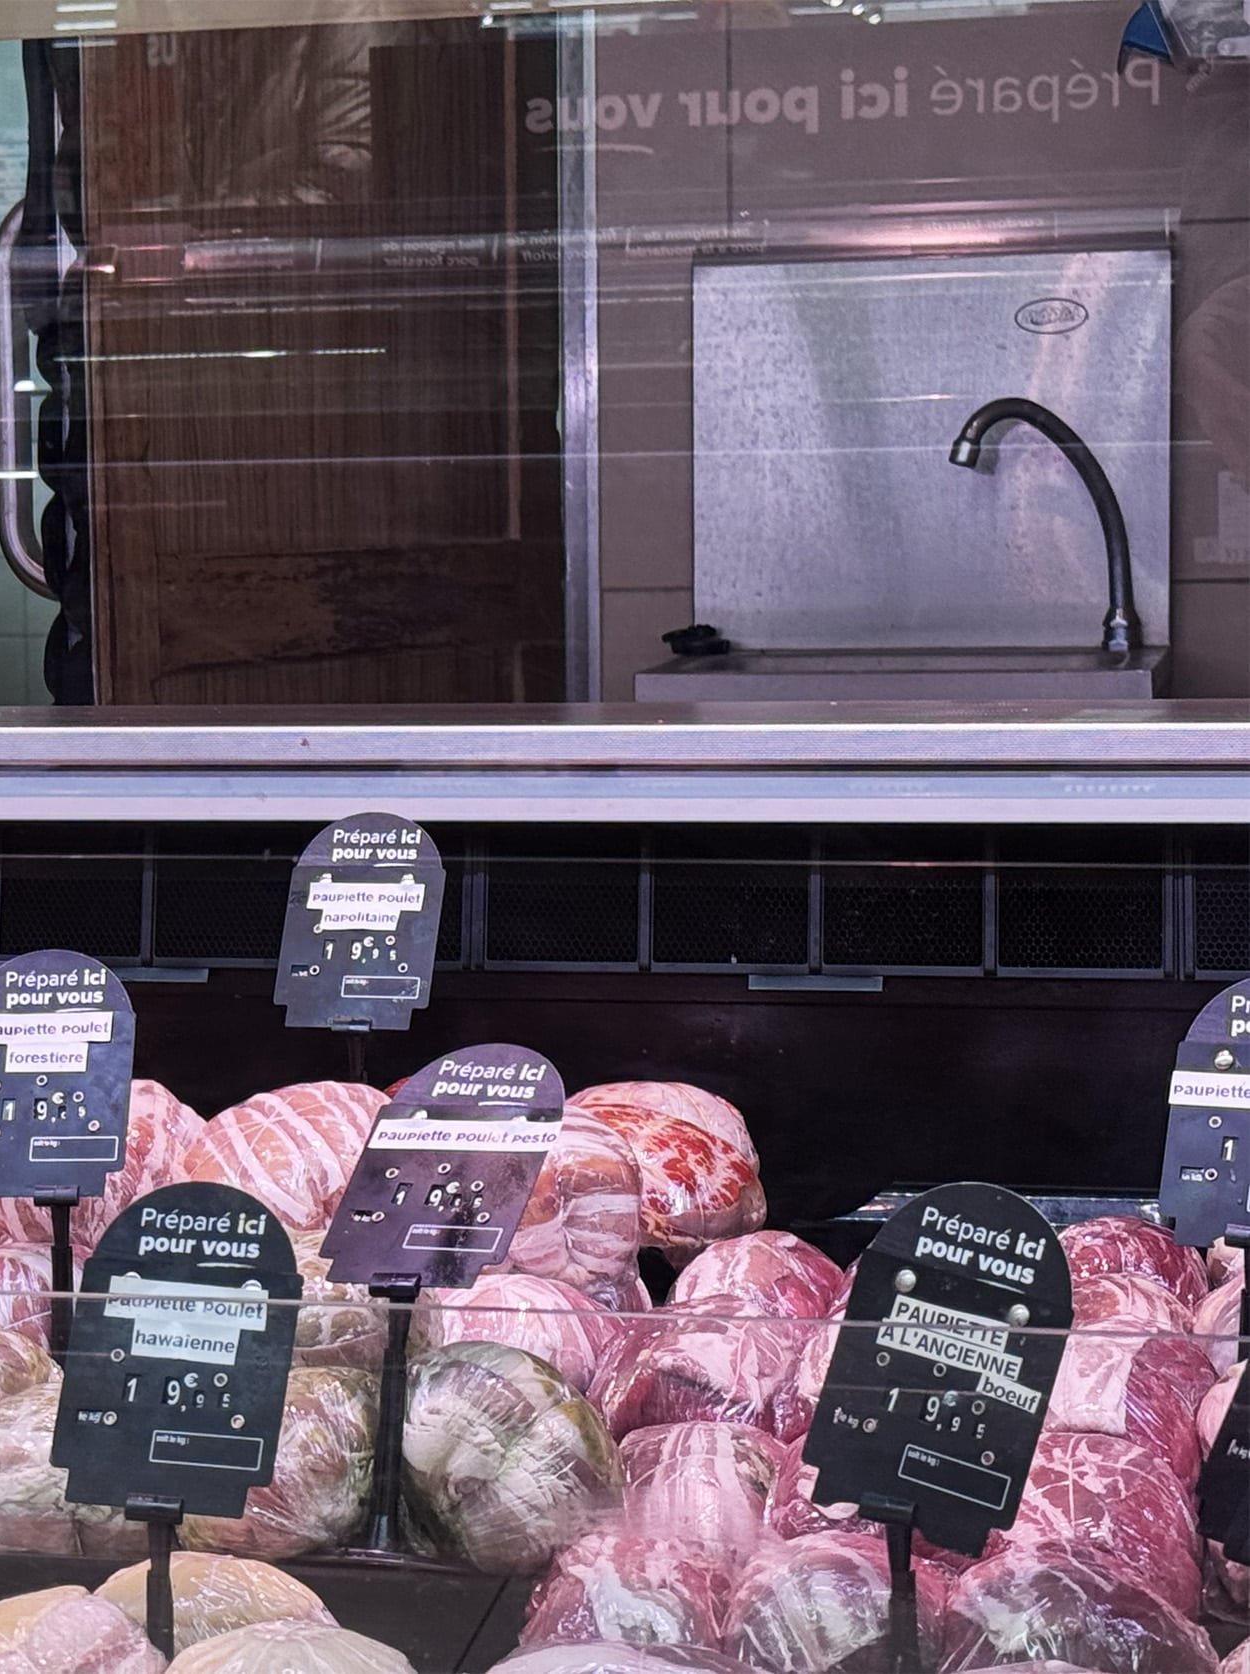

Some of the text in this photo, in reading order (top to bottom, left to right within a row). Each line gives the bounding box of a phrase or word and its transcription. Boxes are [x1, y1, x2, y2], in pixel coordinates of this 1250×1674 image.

[333, 829, 422, 846] Préparé ici
[332, 847, 418, 862] pour vous
[378, 892, 421, 903] poulet
[324, 912, 398, 924] napolitaine
[5, 968, 107, 991] Préparé ici
[6, 990, 104, 1009] pour vous
[61, 1020, 109, 1035] poulet
[438, 1060, 547, 1081] Préparé ici
[432, 1080, 536, 1099] pour vous
[377, 1129, 451, 1142] paupiette
[511, 1132, 557, 1144] pesto
[140, 1207, 267, 1235] Préparé ici
[921, 1206, 1046, 1261] Préparé ici
[138, 1235, 260, 1258] pour vous
[915, 1235, 1035, 1285] pour vous
[202, 1301, 264, 1319] poulet
[895, 1301, 1004, 1347] PAUPIETTE
[900, 1327, 1020, 1380] L'ANCIENNE
[982, 1377, 1039, 1411] boeuf
